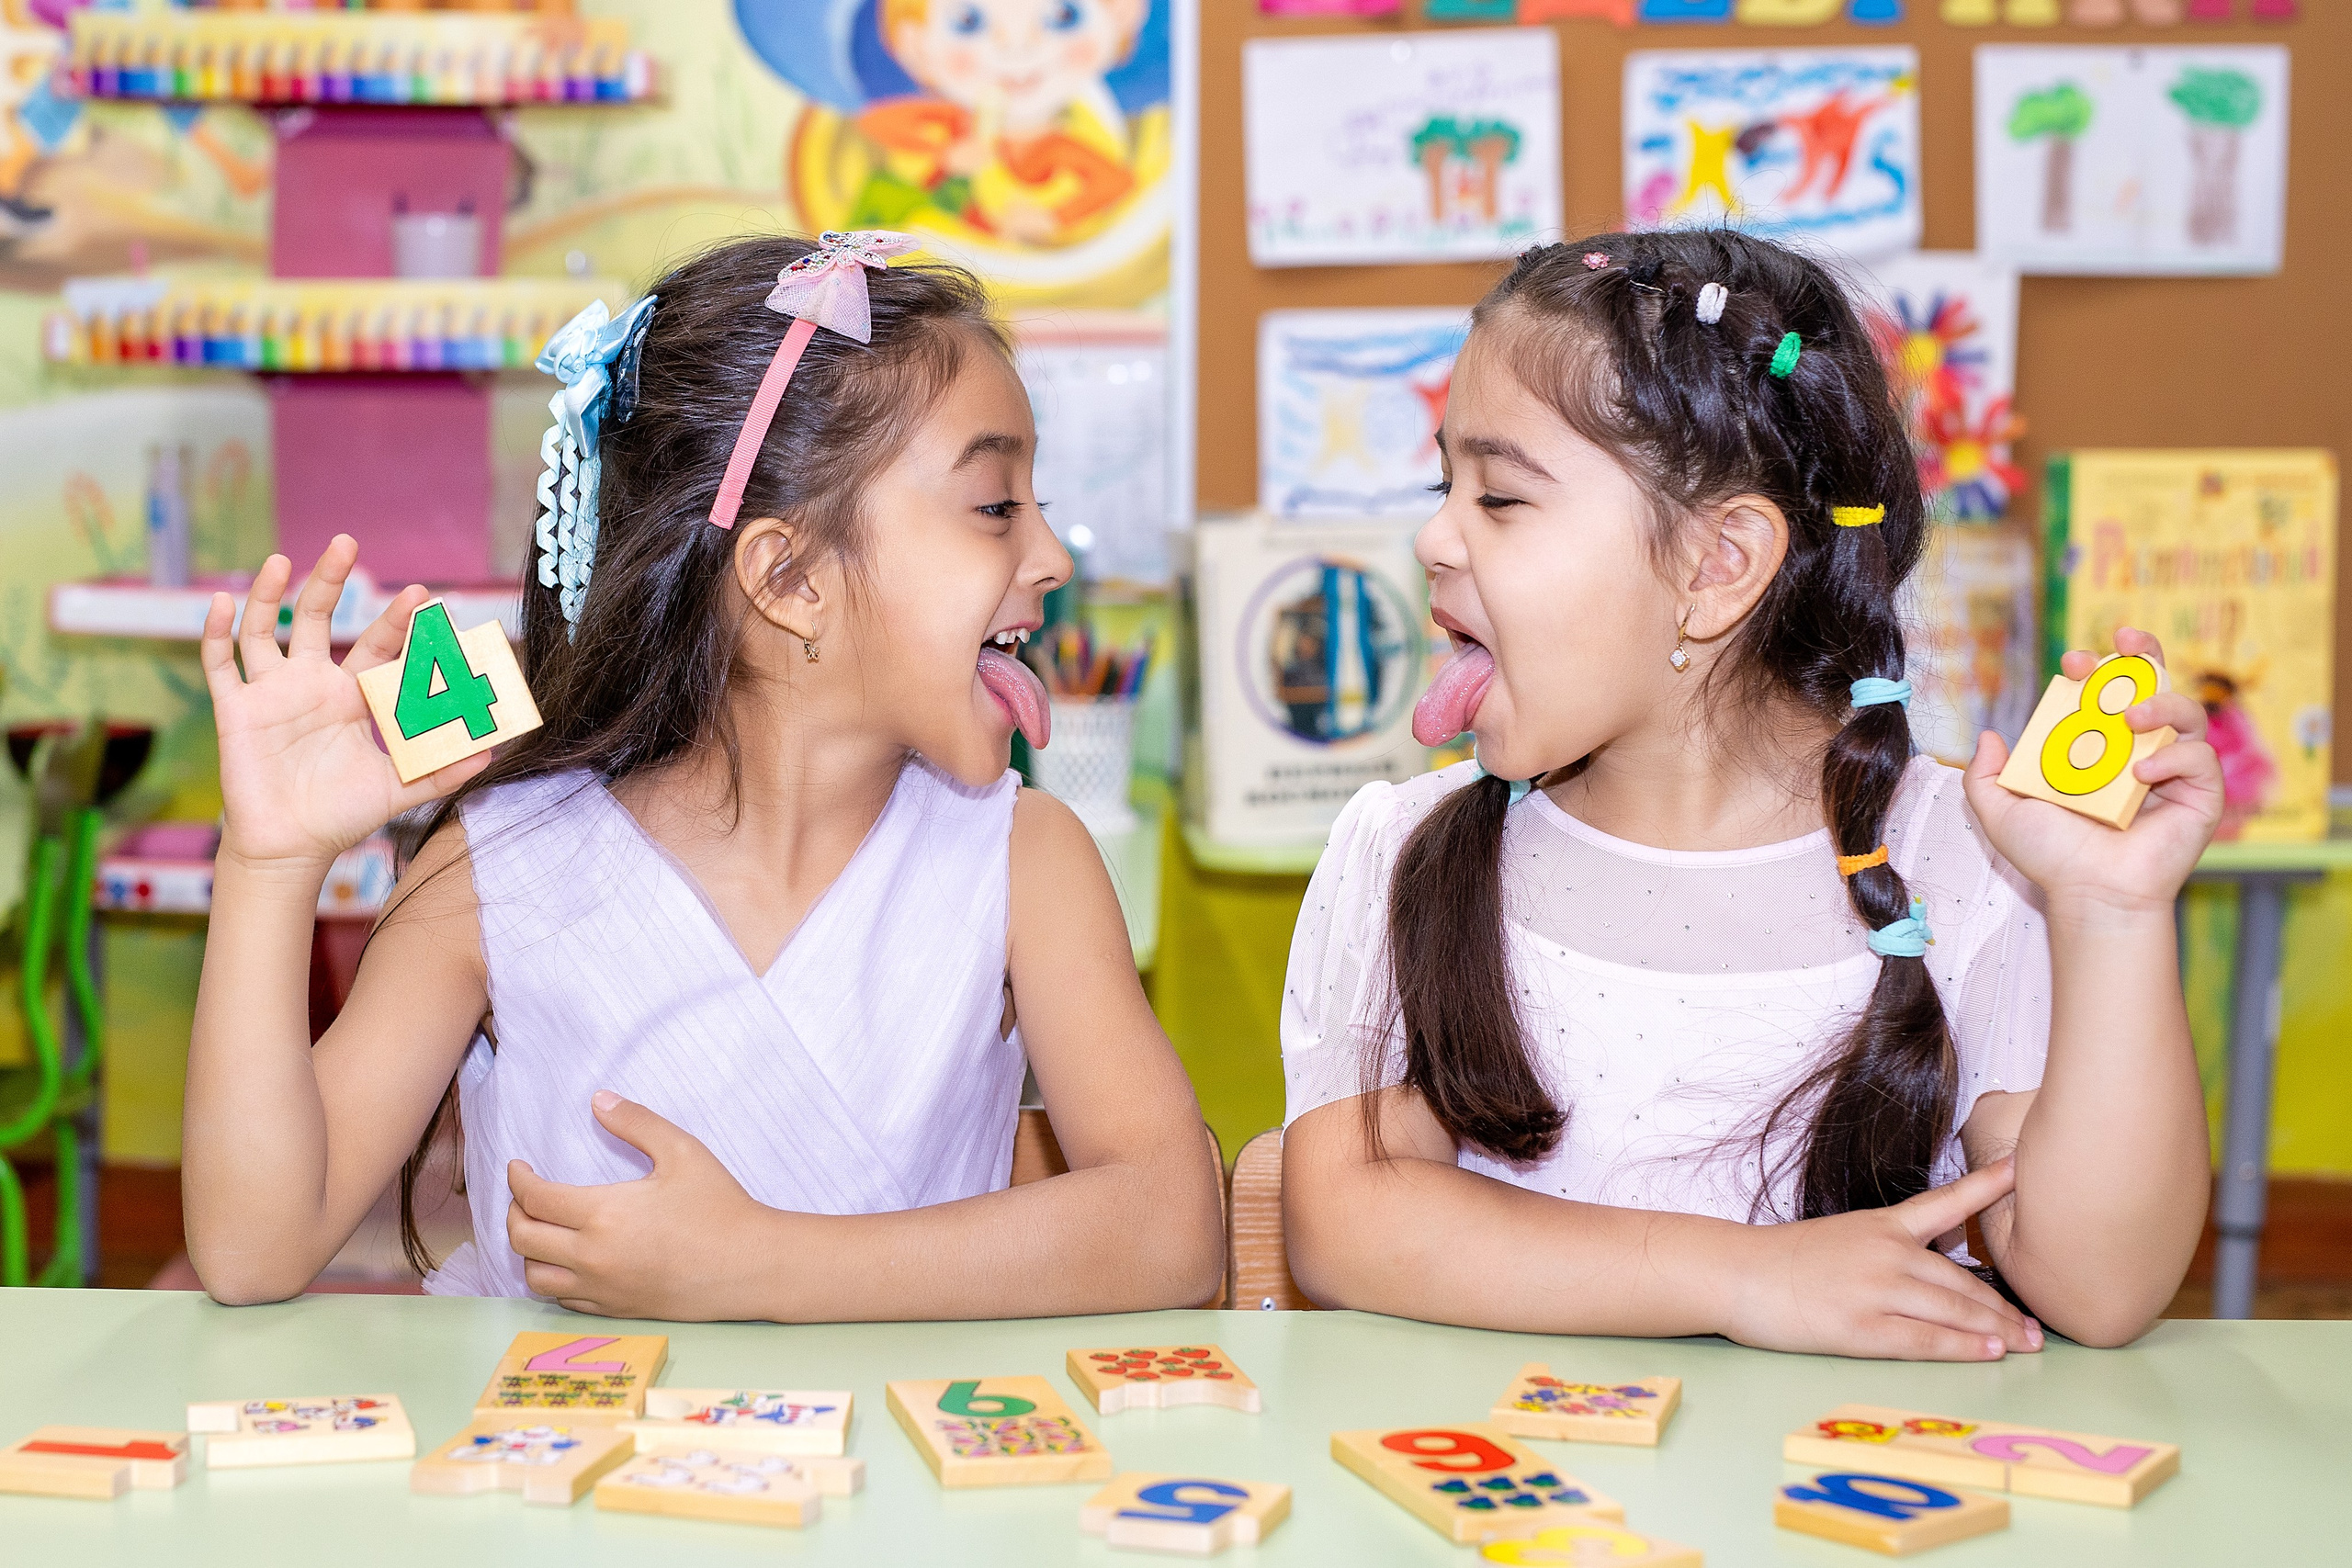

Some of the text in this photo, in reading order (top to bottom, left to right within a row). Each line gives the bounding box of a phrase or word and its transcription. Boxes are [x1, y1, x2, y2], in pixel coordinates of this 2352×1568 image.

[395, 603, 498, 740] 4
[2041, 655, 2157, 795] 8
[1971, 1435, 2155, 1475] 2
[1116, 1481, 1250, 1524] 5
